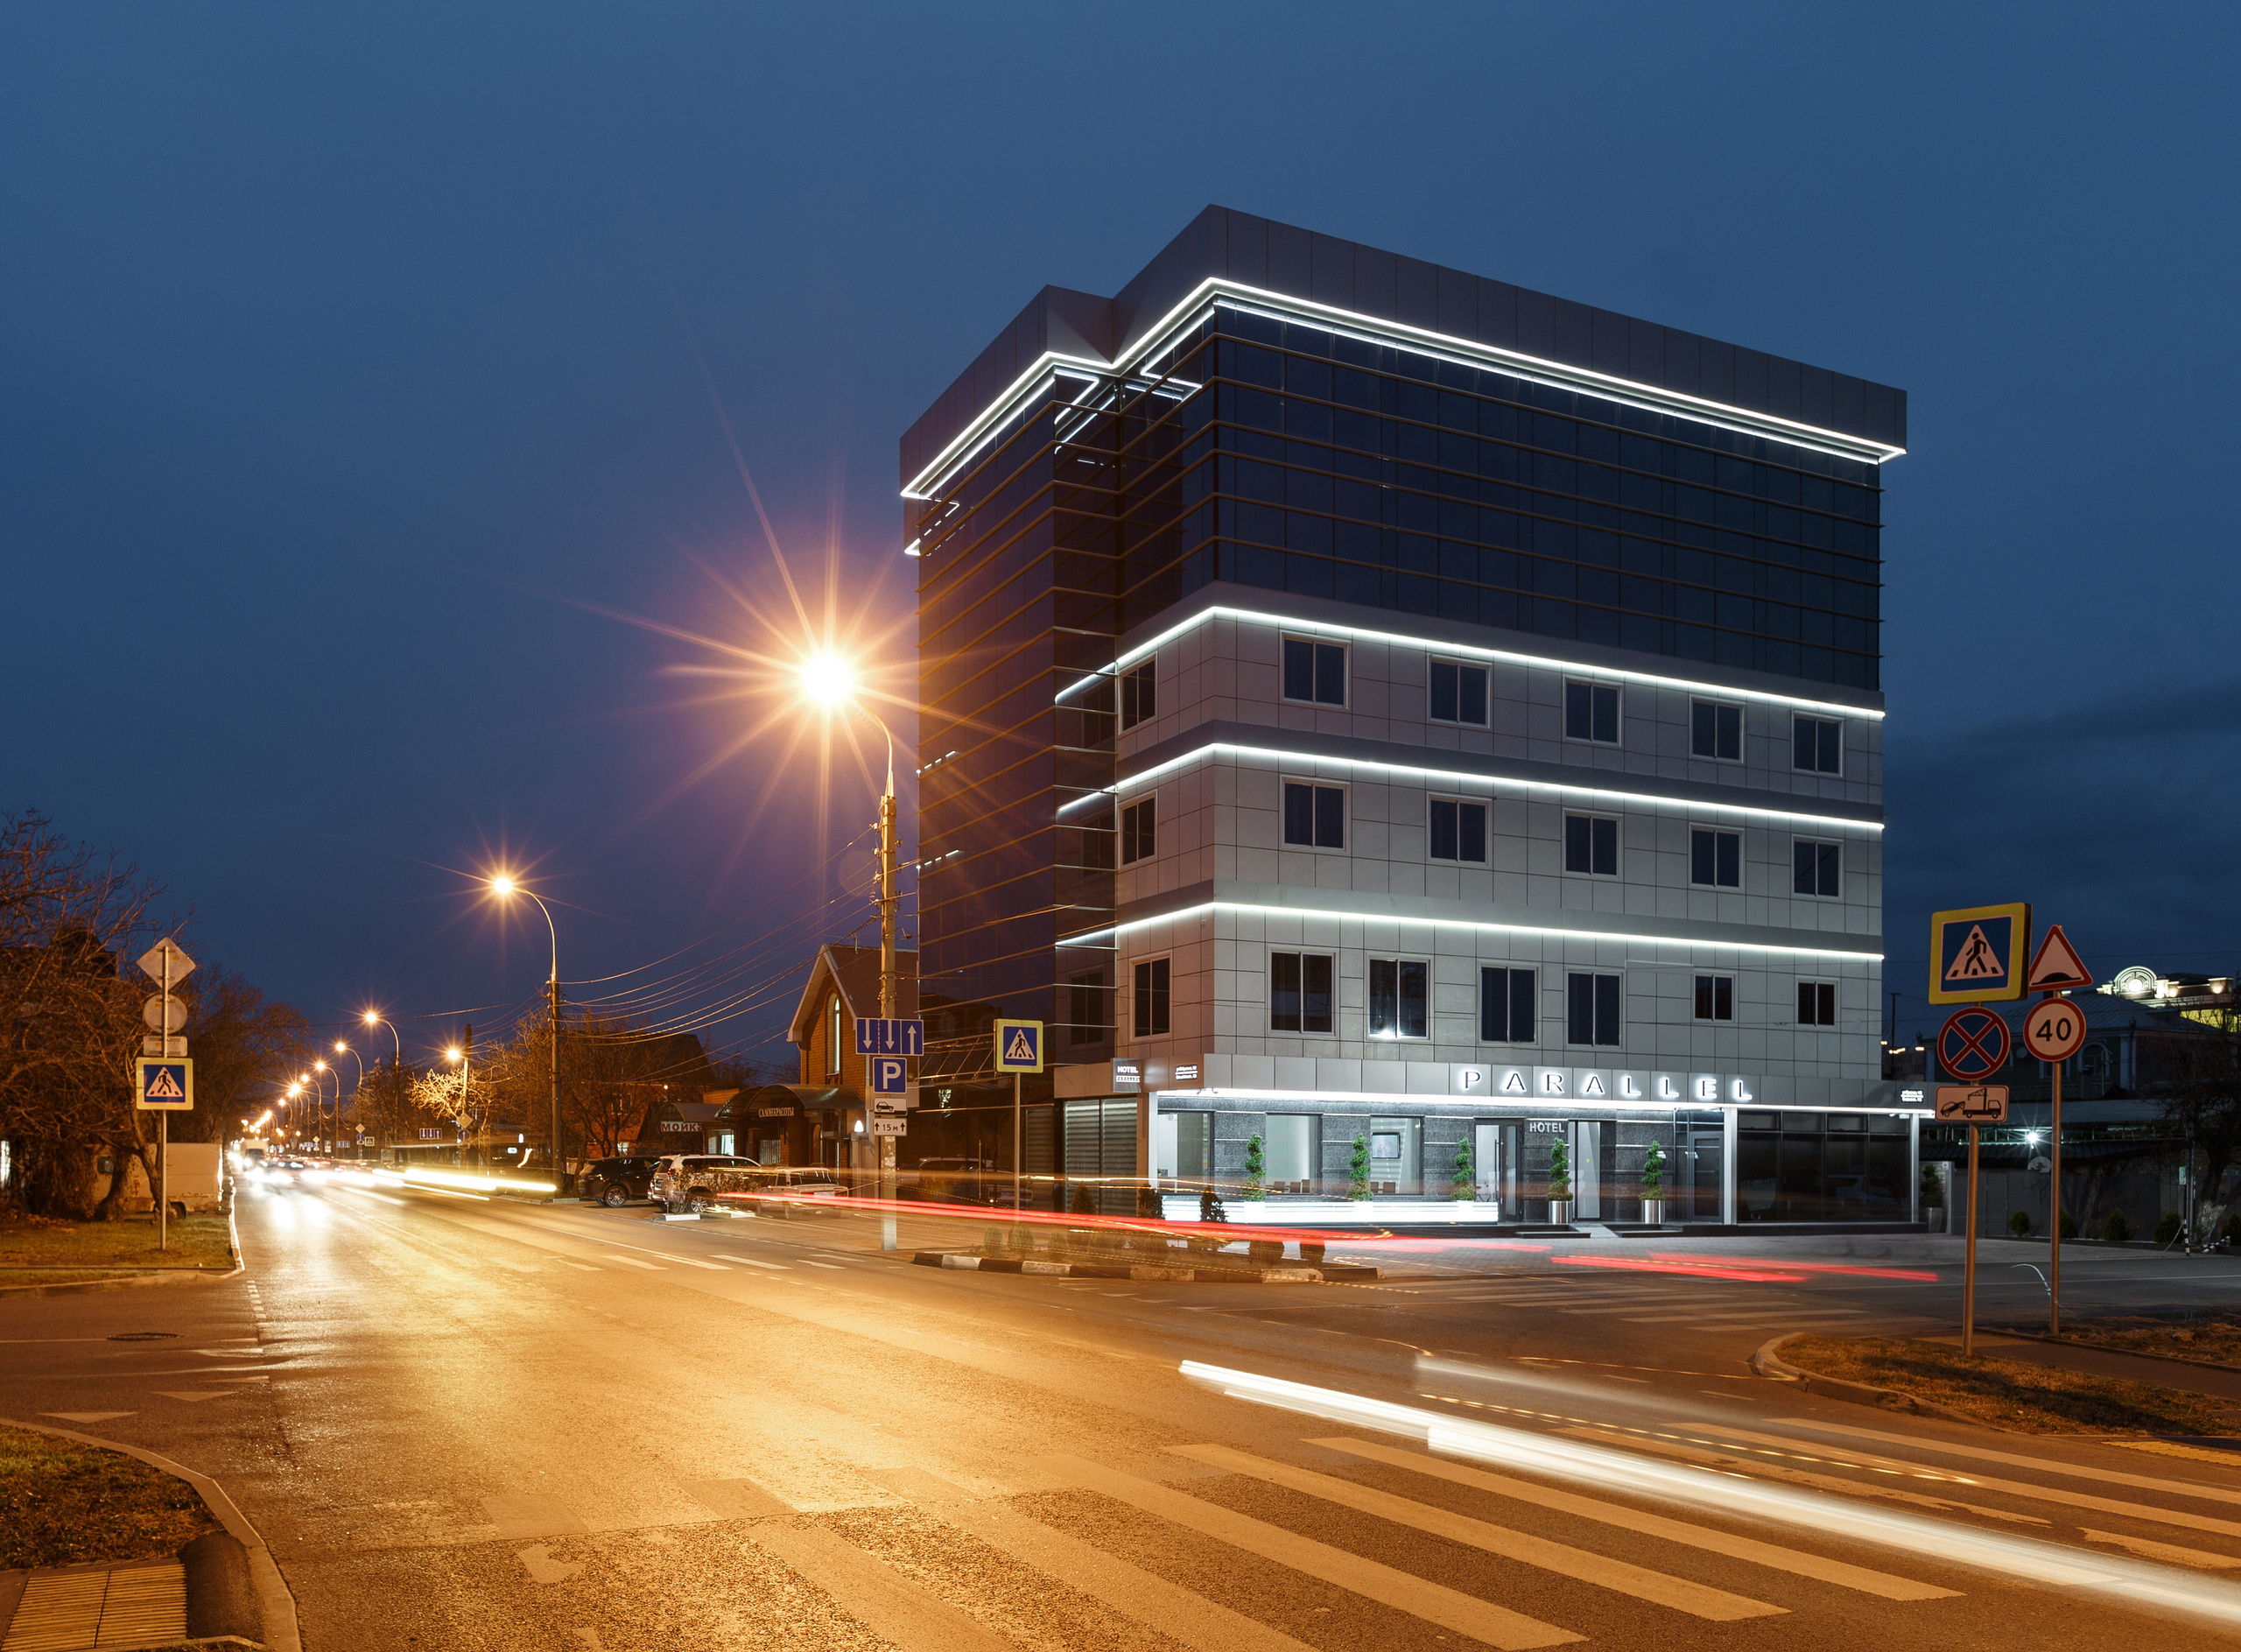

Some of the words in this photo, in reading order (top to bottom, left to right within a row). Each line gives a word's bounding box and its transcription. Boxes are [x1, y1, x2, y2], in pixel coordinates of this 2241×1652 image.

[2035, 1017, 2072, 1042] 40
[882, 1061, 902, 1090] P
[1463, 1071, 1753, 1100] PARALLEL
[1529, 1121, 1565, 1134] HOTEL
